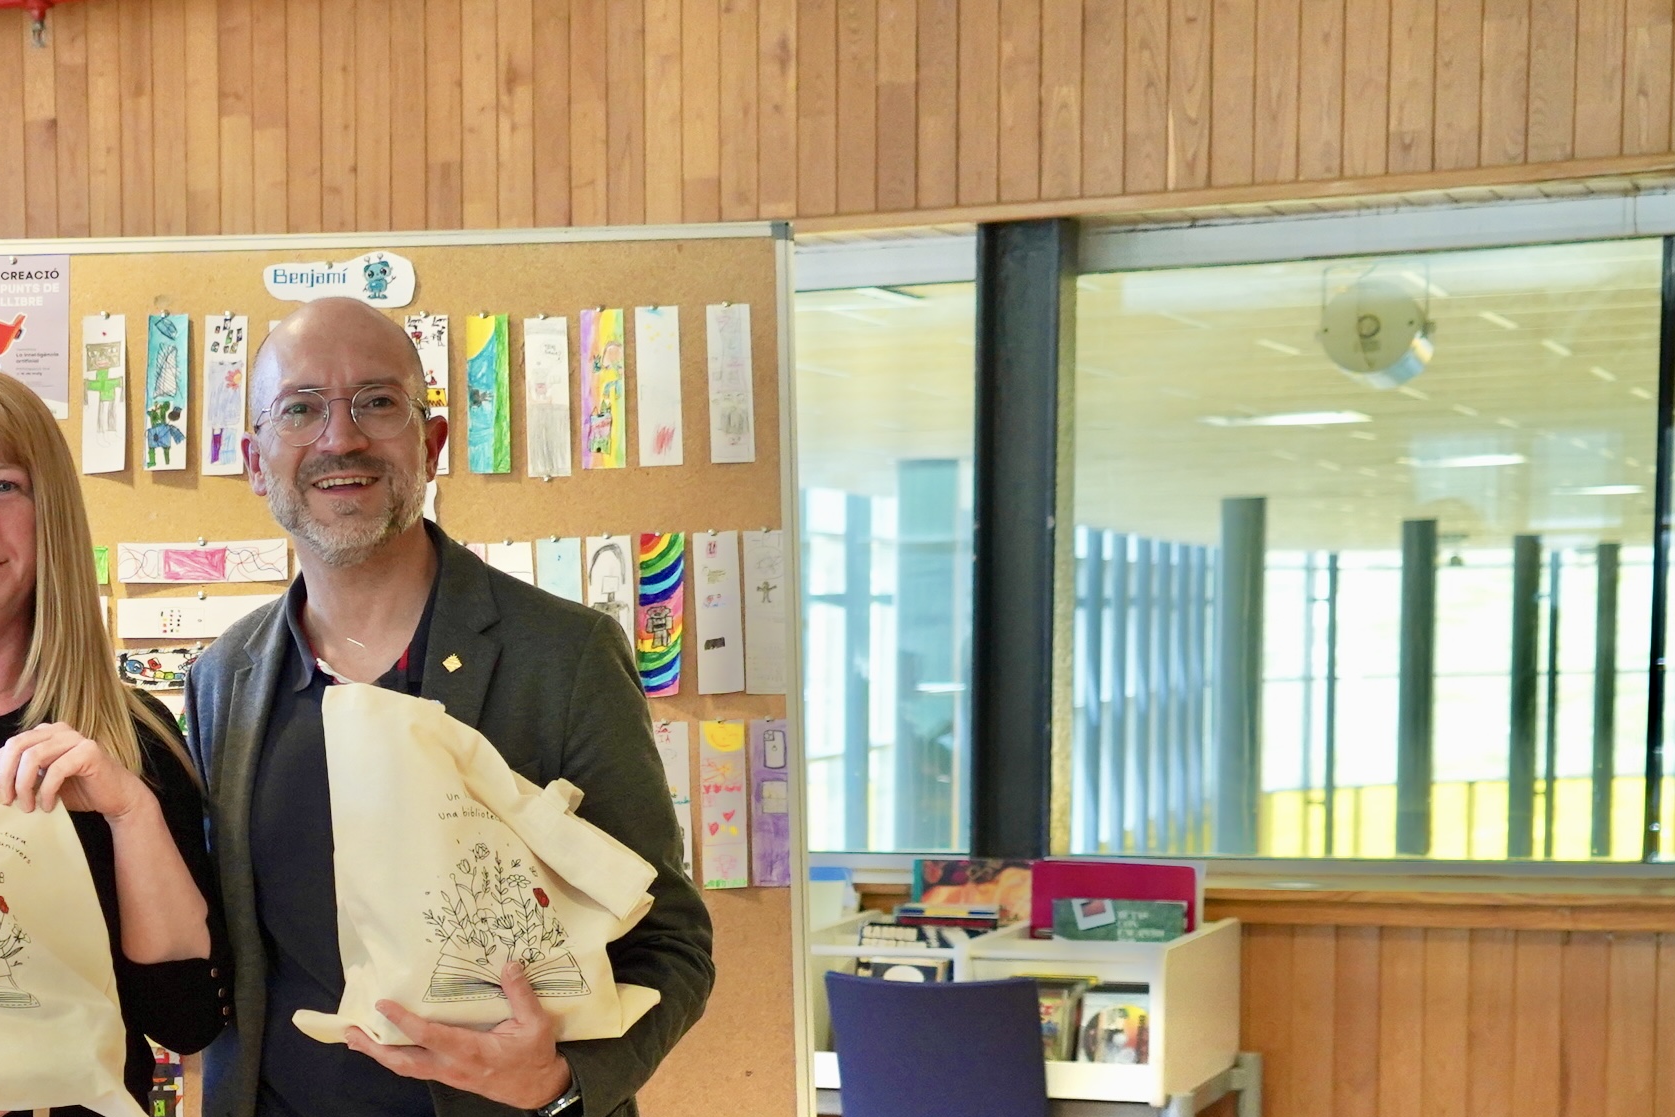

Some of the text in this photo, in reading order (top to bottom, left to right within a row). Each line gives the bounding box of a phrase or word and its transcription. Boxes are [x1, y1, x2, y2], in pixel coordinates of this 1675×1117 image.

[0, 268, 60, 280] CREACIÓ
[273, 267, 348, 288] Benjamí
[0, 282, 60, 294] PUNTS DE
[0, 296, 43, 307] LLIBRE
[445, 792, 460, 802] Un
